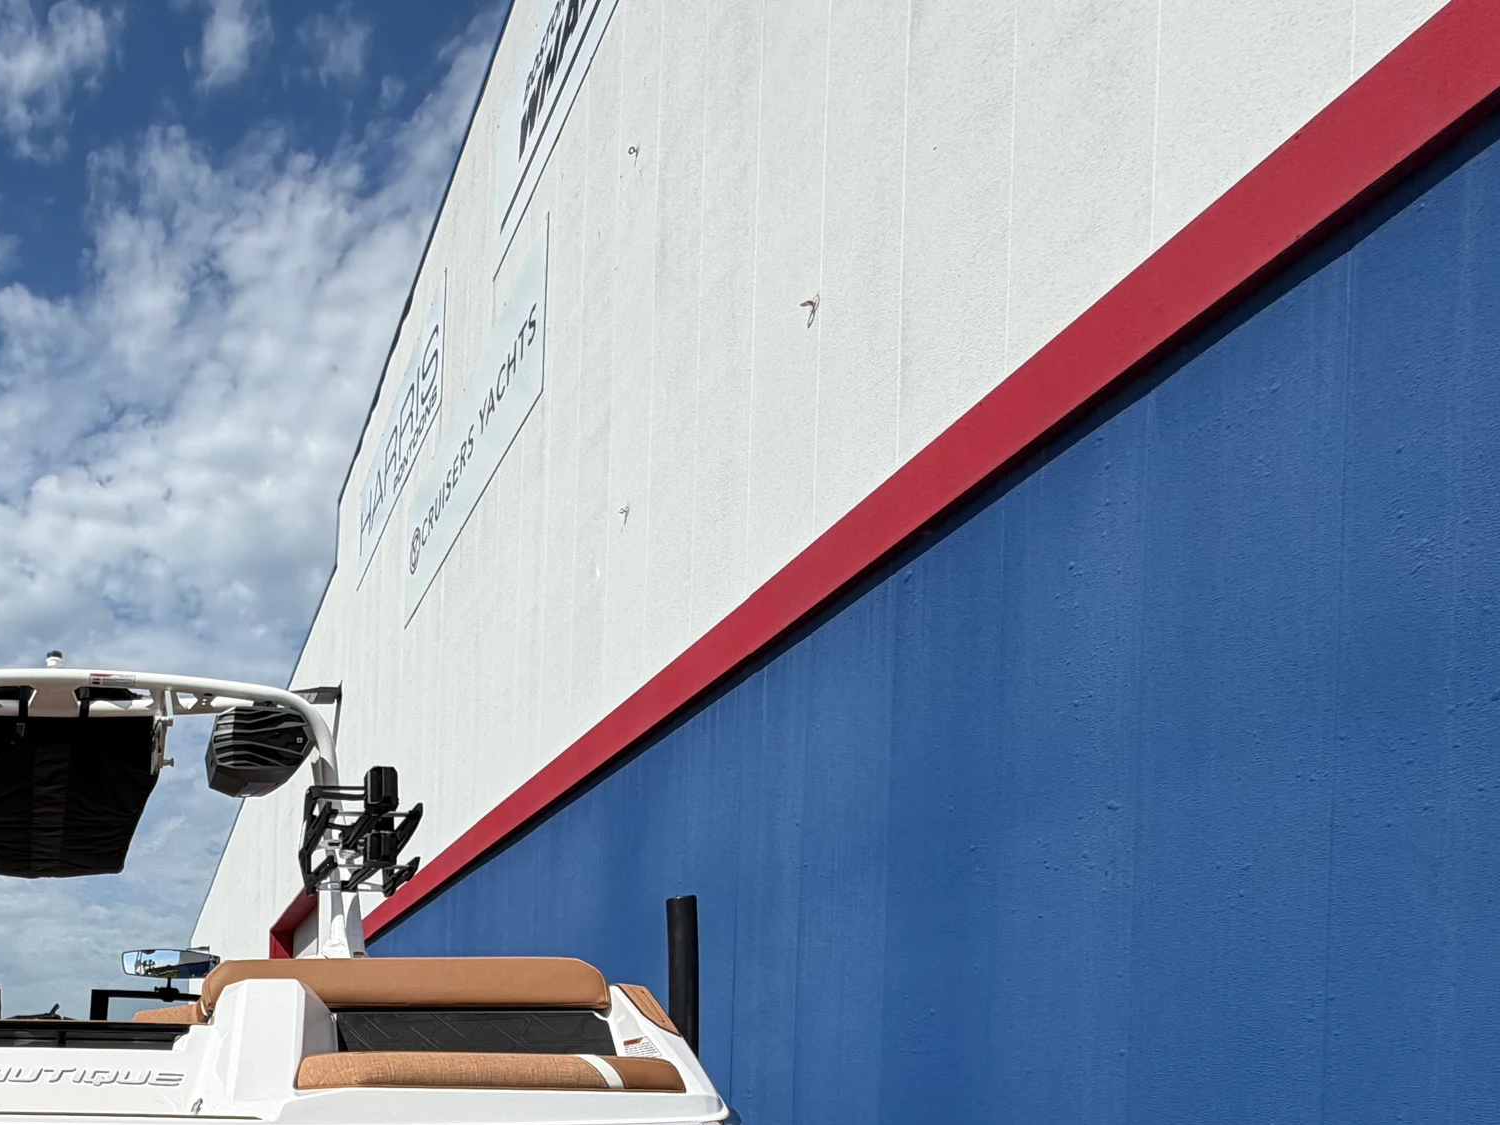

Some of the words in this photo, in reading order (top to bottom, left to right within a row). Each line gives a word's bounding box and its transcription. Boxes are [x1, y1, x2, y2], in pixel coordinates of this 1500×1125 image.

[359, 323, 439, 557] HARRIS
[393, 384, 438, 494] PONTOONS
[421, 423, 475, 547] CRUISERS
[479, 302, 537, 435] YACHTS
